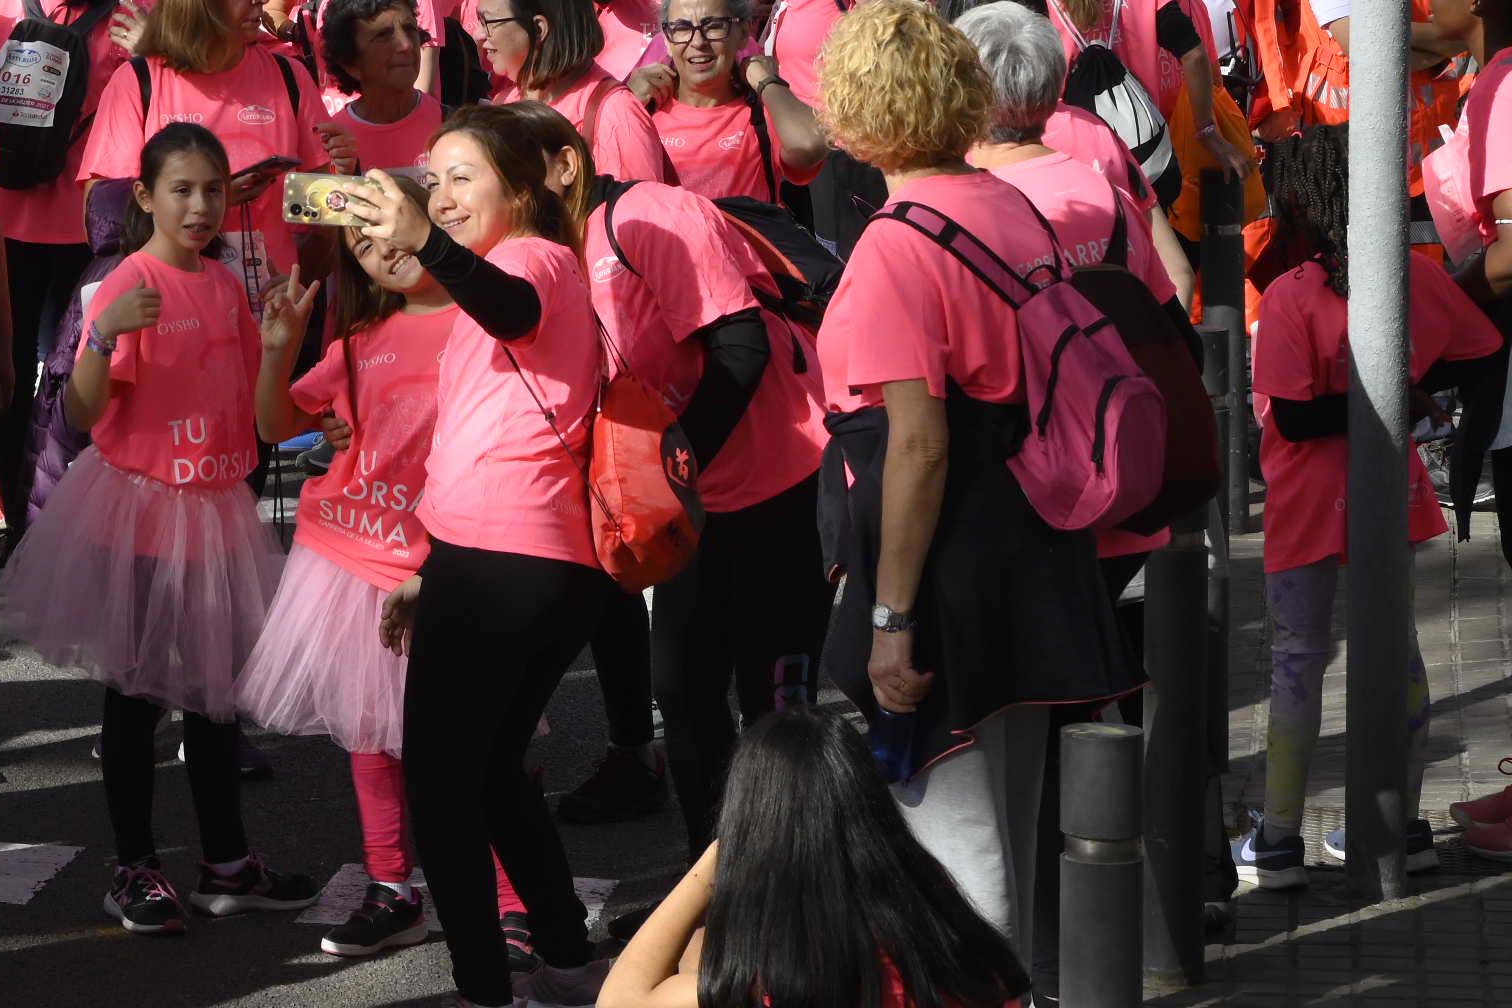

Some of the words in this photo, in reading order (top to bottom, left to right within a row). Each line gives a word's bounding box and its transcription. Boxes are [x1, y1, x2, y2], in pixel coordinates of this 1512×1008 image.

[1, 71, 32, 85] 016
[157, 319, 200, 335] OYSHO
[168, 416, 212, 446] TU
[319, 499, 409, 548] SUMA
